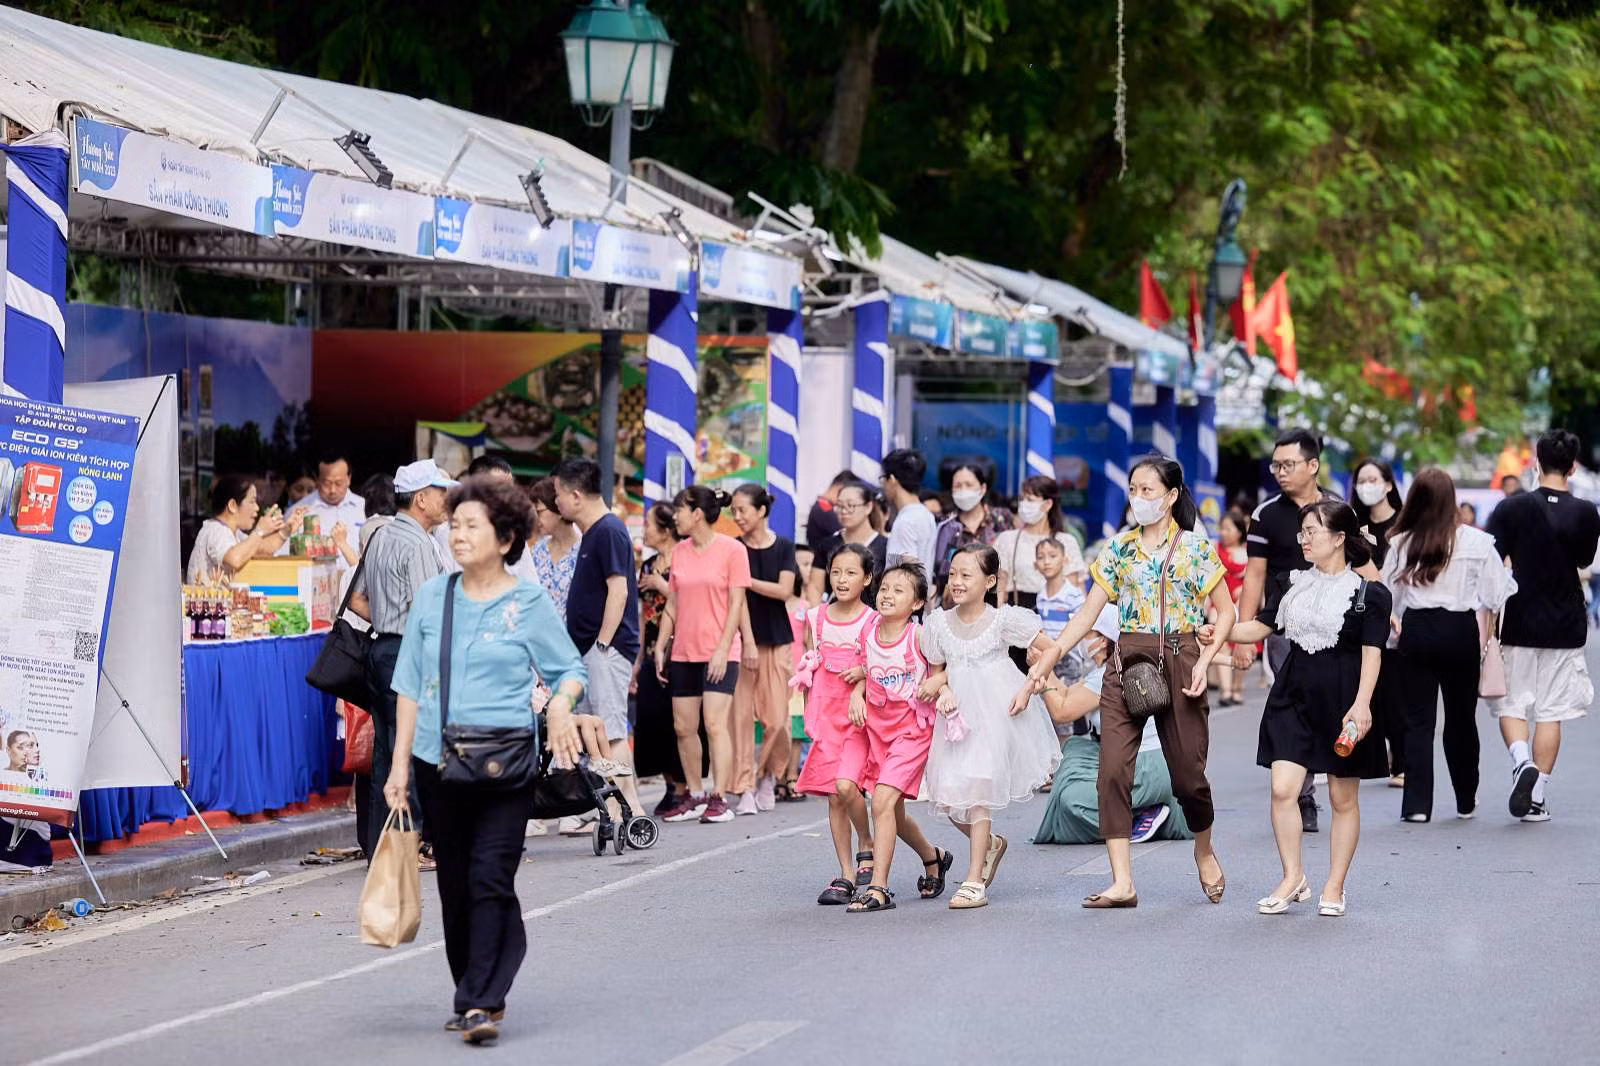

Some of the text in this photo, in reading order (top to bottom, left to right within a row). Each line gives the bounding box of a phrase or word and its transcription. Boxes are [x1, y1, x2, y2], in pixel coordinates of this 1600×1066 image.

[13, 400, 28, 408] HỌC
[111, 417, 127, 425] NAM
[15, 414, 88, 434] TẬP ĐOÀN ECO G9
[11, 429, 49, 445] ECO
[9, 443, 29, 454] ĐIỆN
[49, 449, 65, 460] ION
[89, 455, 109, 467] TÍCH
[110, 460, 130, 471] HỢP
[78, 465, 123, 481] NÓNG LẠNH
